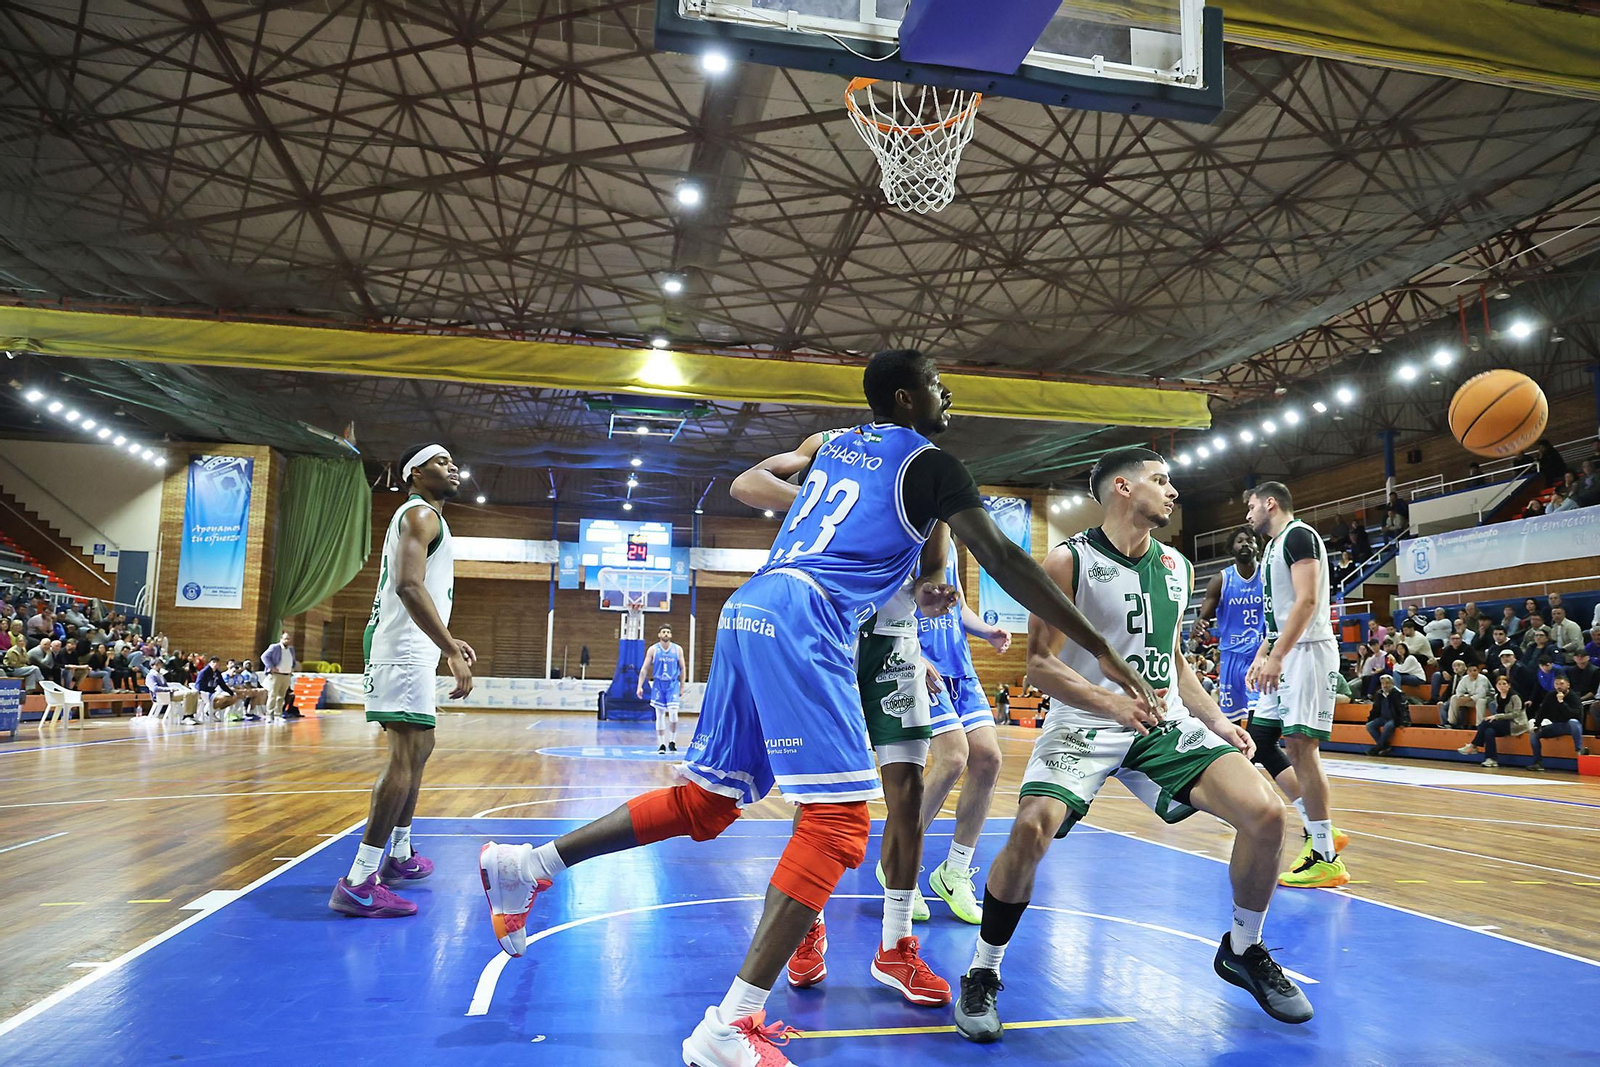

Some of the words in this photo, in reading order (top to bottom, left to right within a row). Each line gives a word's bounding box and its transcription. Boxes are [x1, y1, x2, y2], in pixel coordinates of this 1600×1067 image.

[821, 443, 883, 471] CHABIYO
[772, 469, 860, 564] 23
[191, 524, 241, 537] Apoyamos
[191, 534, 203, 543] tu
[204, 533, 241, 546] esfuerzo
[1436, 529, 1499, 547] Ayuntamiento
[628, 545, 647, 559] 24
[1124, 592, 1155, 635] 21
[1242, 609, 1259, 626] 25
[1124, 648, 1171, 679] oto
[1220, 691, 1234, 708] 25
[764, 738, 803, 748] YUNDAI
[1065, 733, 1096, 752] Hospital
[1045, 760, 1086, 779] IMDECO
